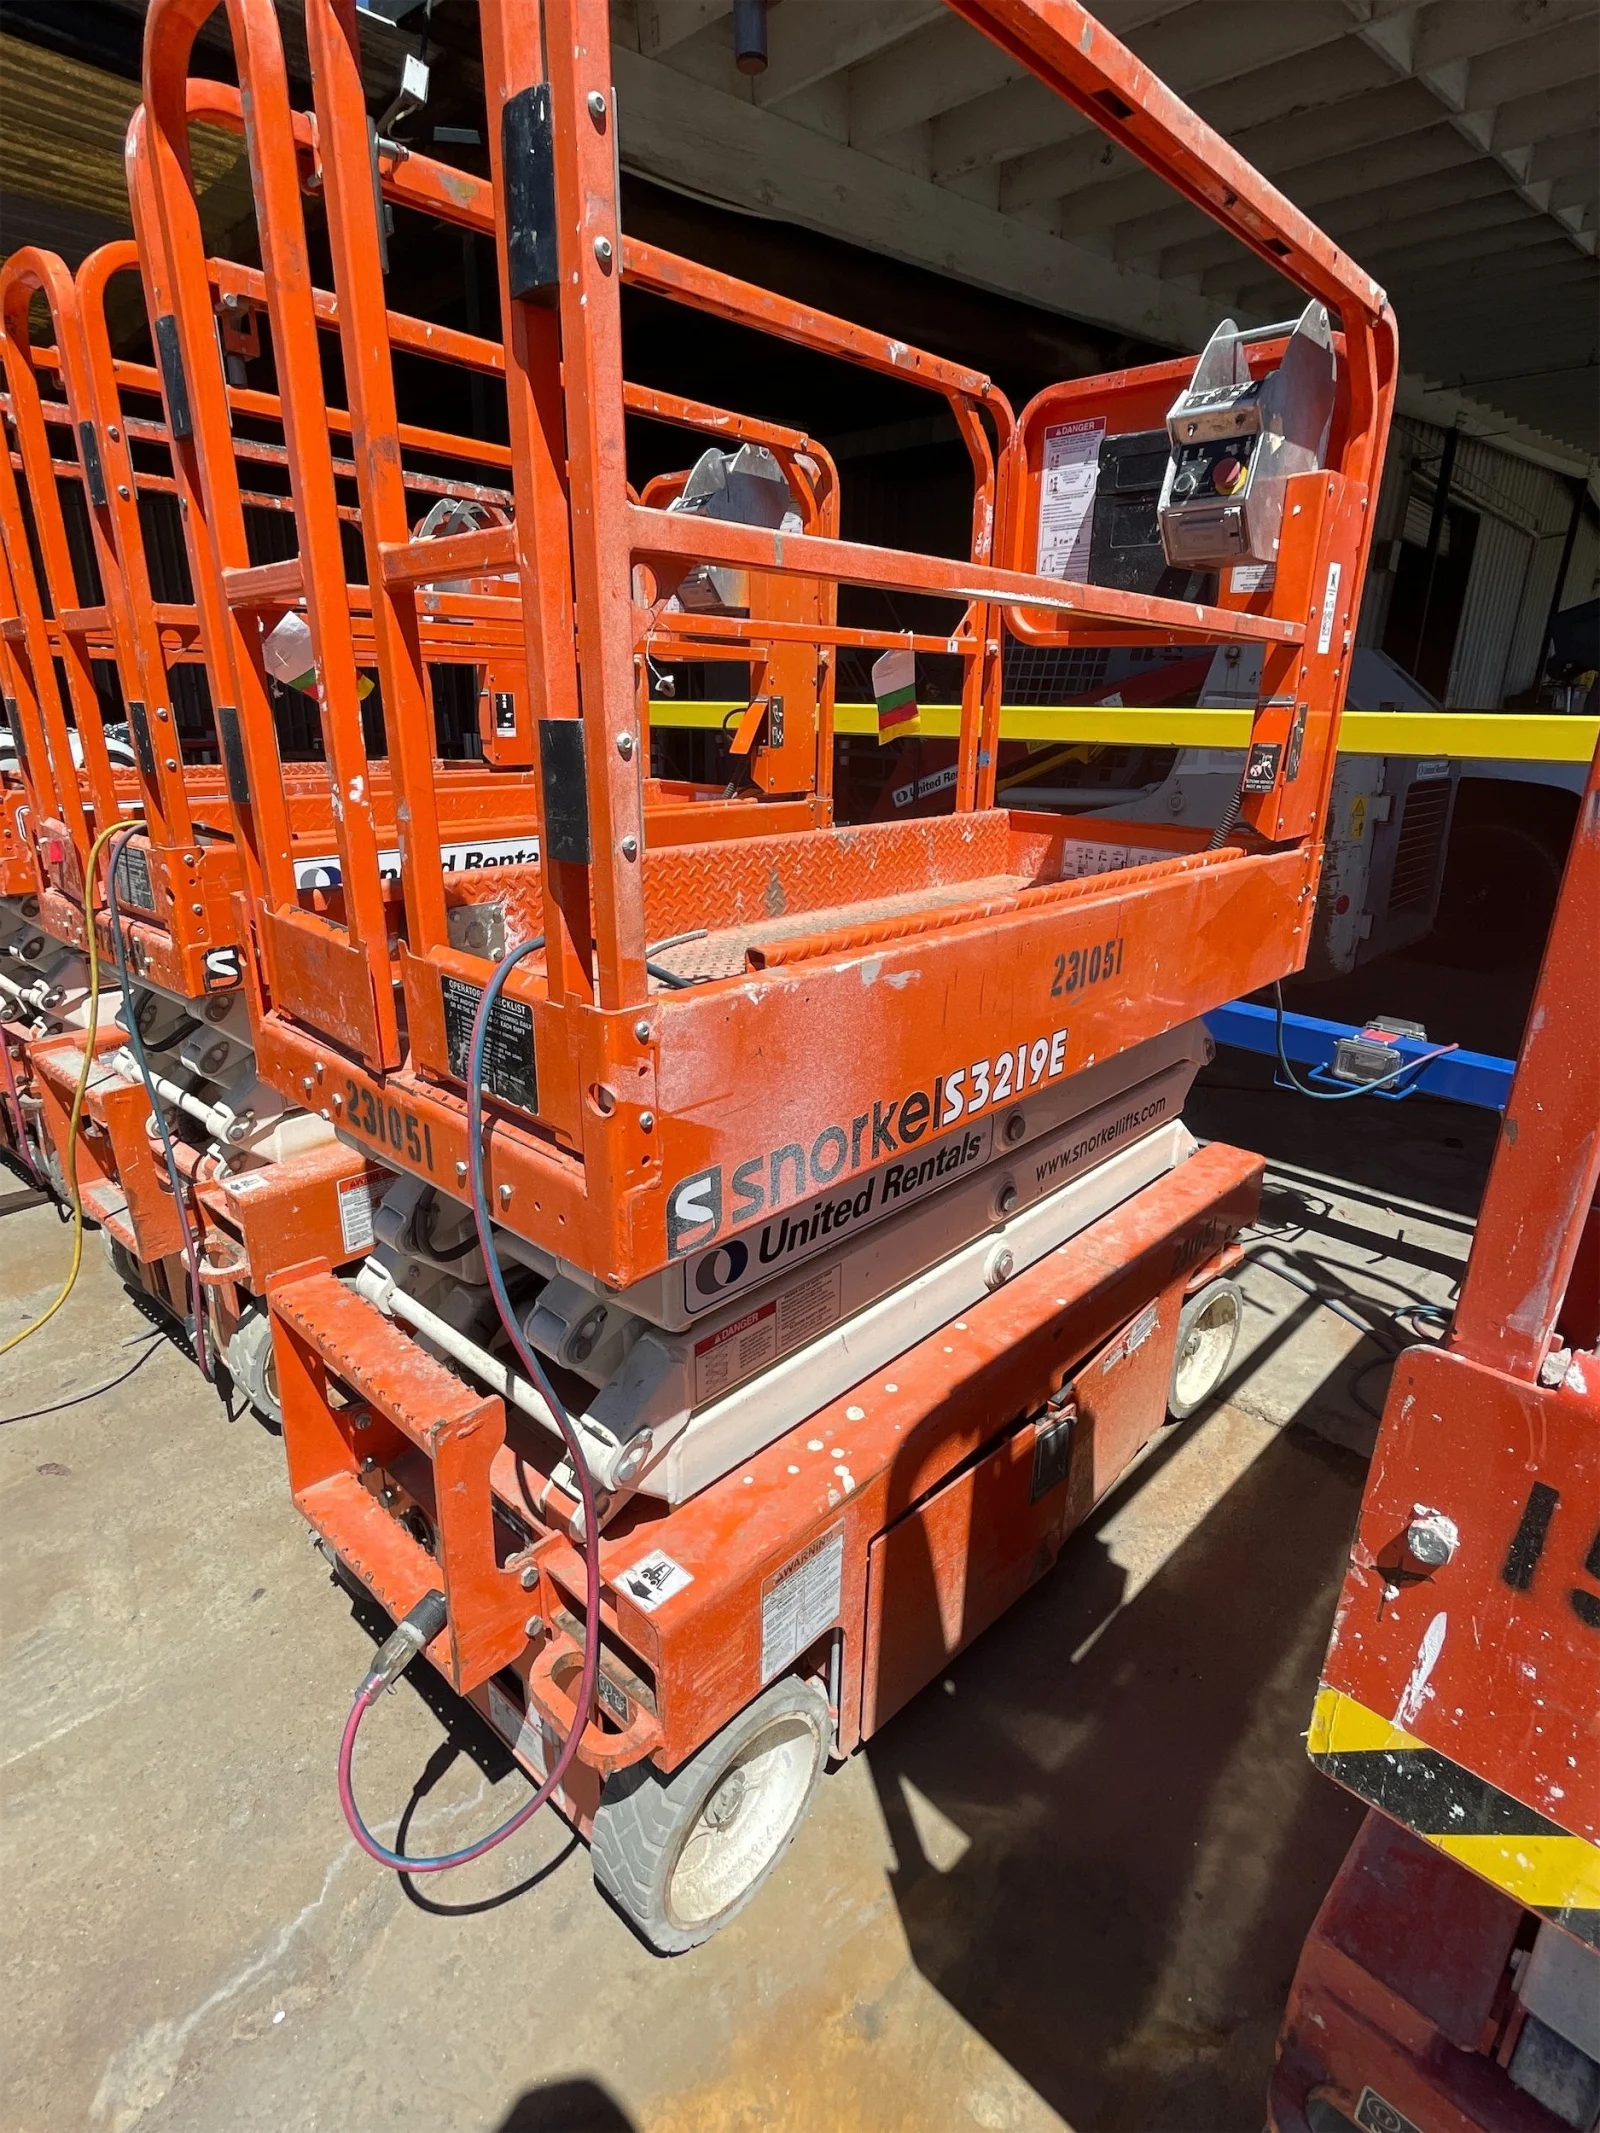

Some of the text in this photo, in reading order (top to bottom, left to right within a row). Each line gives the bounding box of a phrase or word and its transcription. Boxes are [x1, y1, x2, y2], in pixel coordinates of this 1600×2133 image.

[1062, 421, 1095, 435] DANGER
[345, 1078, 435, 1173] 231051
[731, 1027, 1069, 1225] snorkel S3219E
[1035, 1097, 1166, 1182] www.snorkellifts.com
[758, 1131, 982, 1264] United Rentals
[721, 1312, 759, 1339] DANGER
